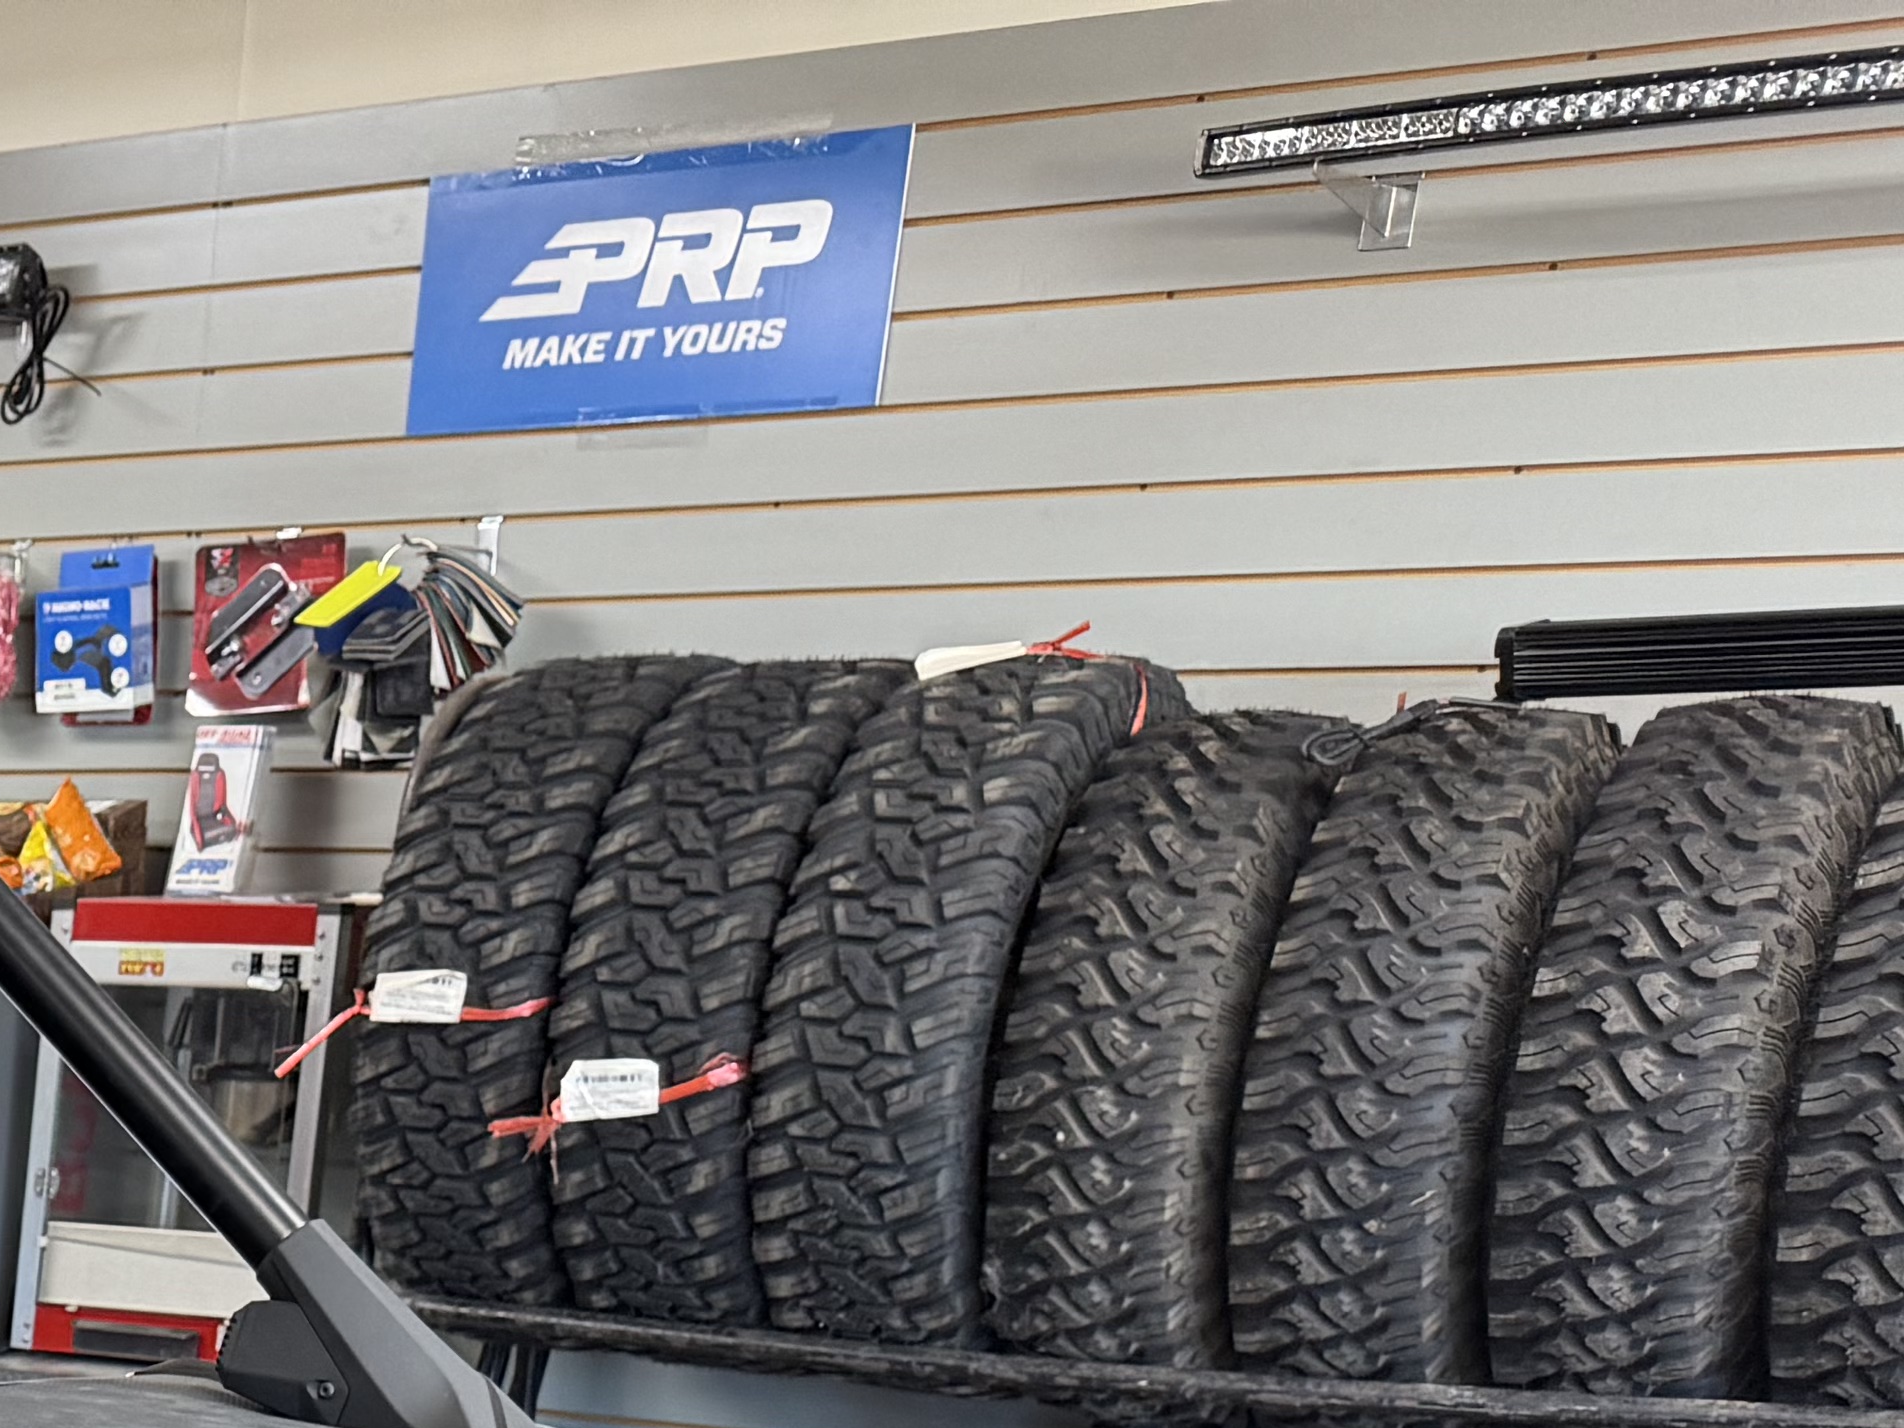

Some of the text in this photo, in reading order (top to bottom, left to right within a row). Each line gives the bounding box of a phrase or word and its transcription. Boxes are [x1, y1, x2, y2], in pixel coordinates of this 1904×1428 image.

[479, 200, 834, 322] PRP
[502, 317, 788, 371] MAKE IT YOURS
